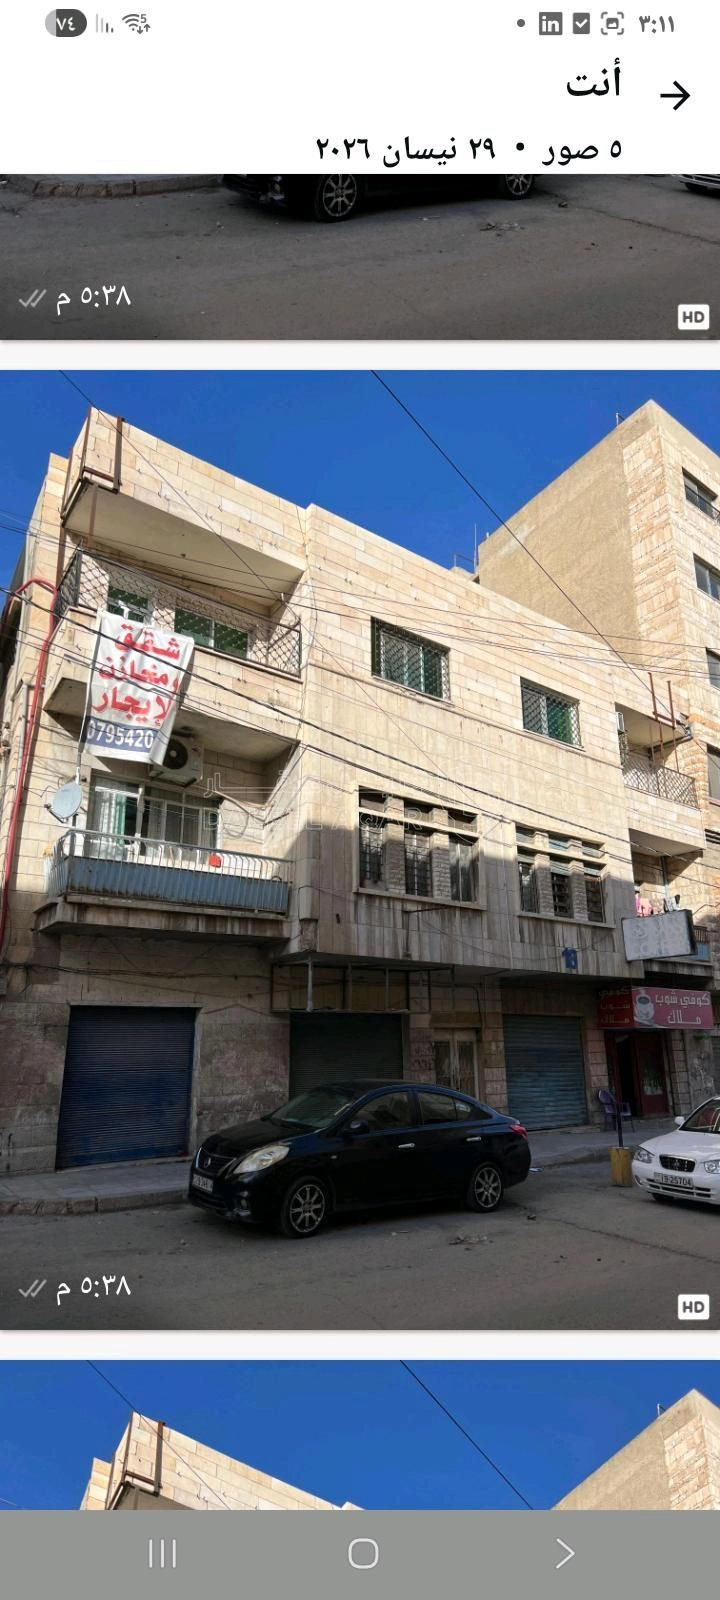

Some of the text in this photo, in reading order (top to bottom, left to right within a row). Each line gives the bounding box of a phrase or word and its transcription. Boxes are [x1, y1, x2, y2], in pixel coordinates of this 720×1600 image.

[56, 16, 76, 32] ٧٤
[541, 15, 559, 33] in
[639, 15, 675, 34] ٣:١١
[566, 58, 621, 97] أنت
[316, 137, 622, 168] ٥ صور ٢٩ نيسان ٢٠٢٦
[655, 988, 711, 1009] كوفي شوب
